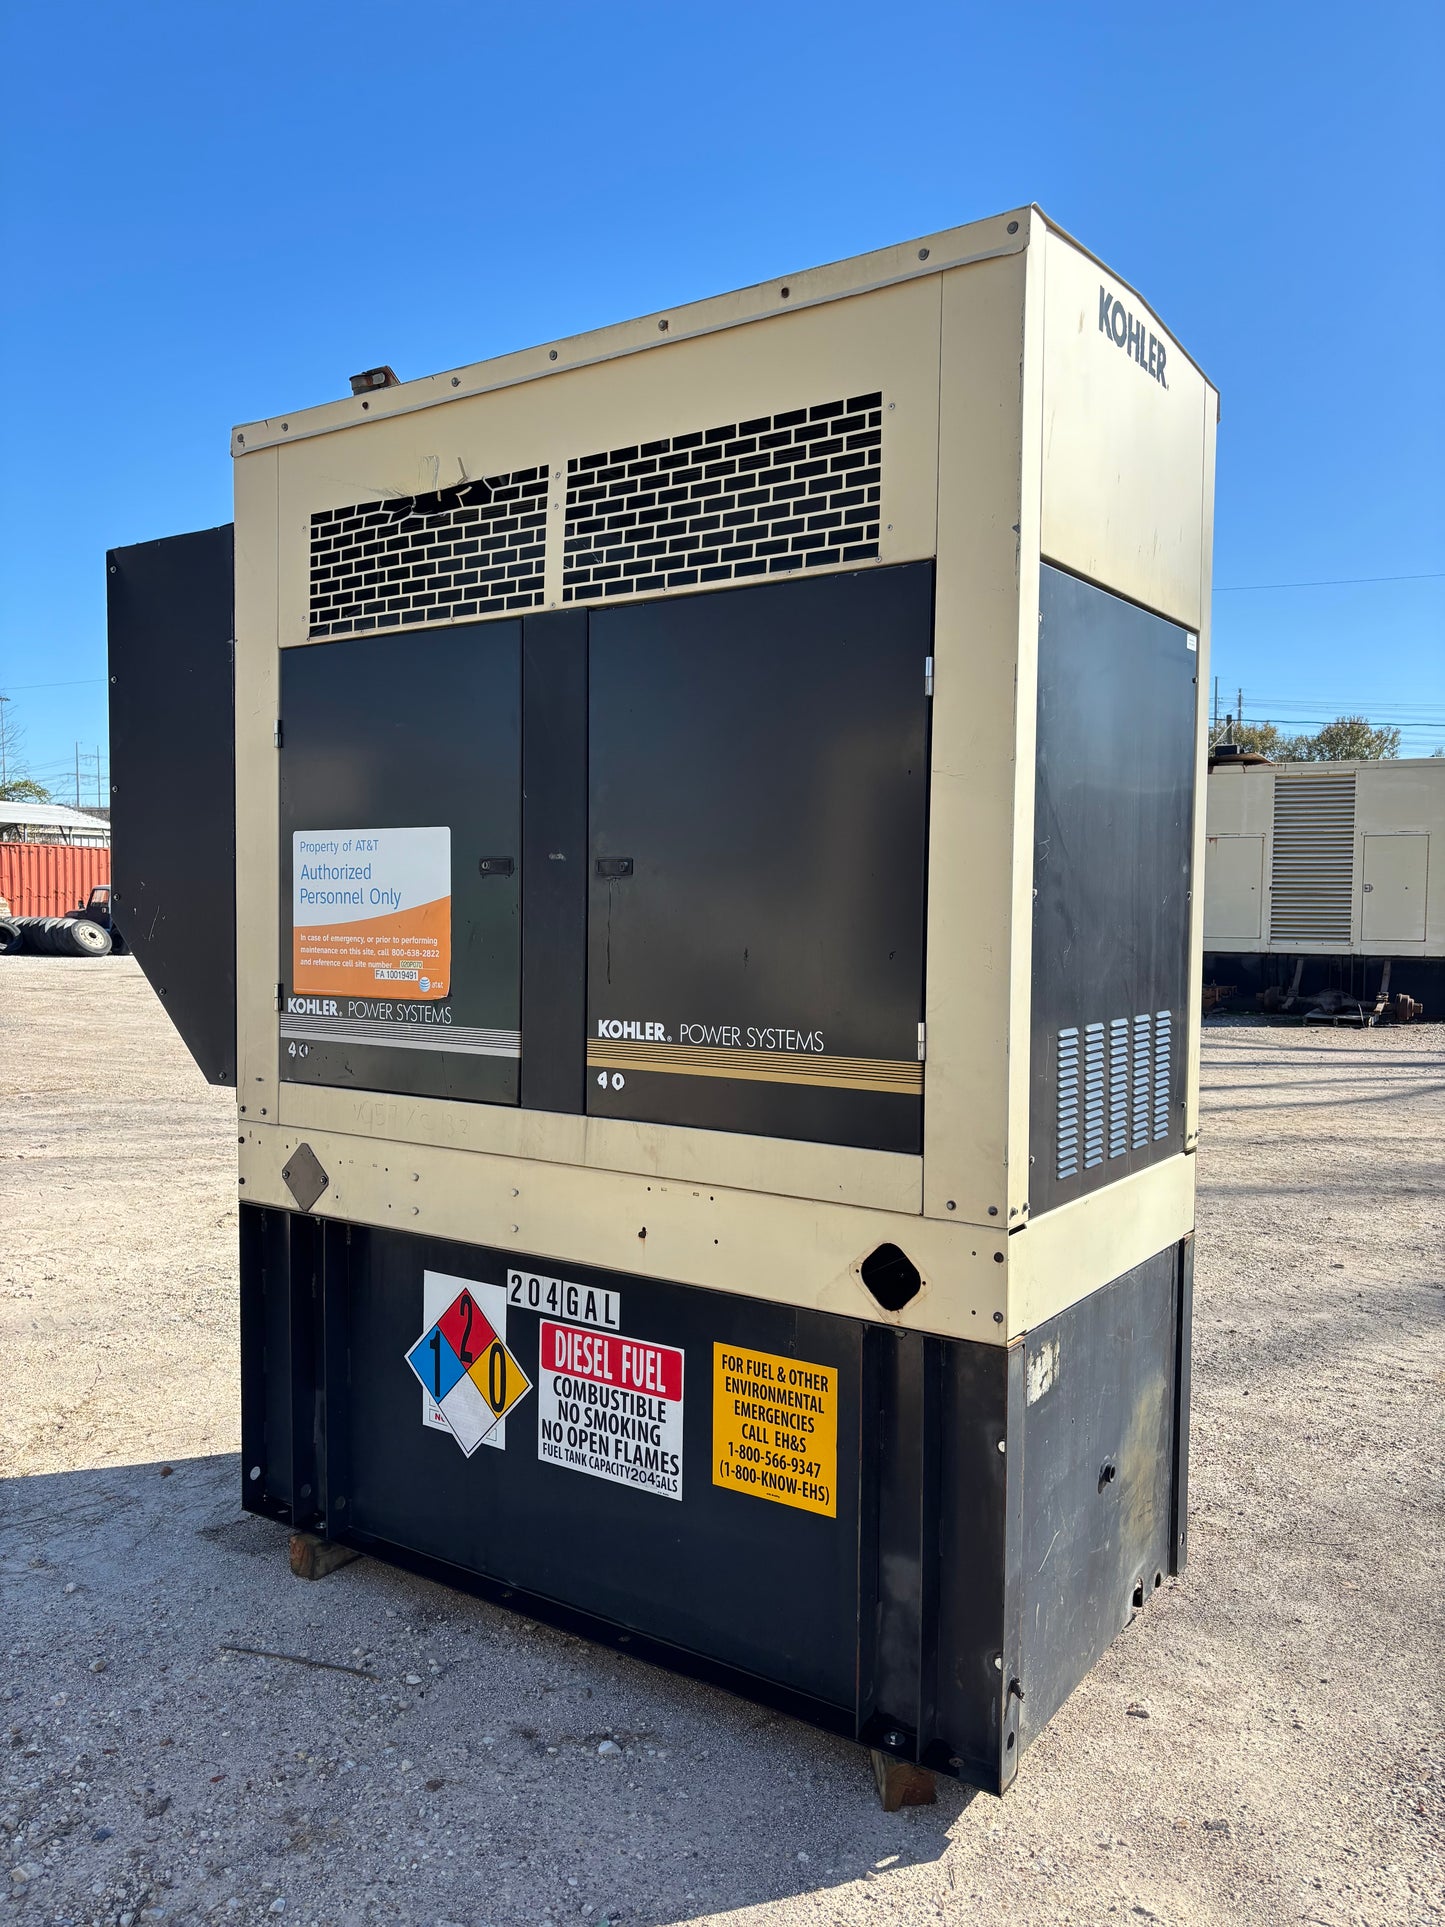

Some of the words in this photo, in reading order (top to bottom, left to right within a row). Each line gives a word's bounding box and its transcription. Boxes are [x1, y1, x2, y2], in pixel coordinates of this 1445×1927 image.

[300, 841, 338, 855] Property
[342, 839, 352, 852] of
[355, 839, 379, 852] AT&T
[300, 862, 372, 880] Authorized
[300, 887, 364, 905] Personnel
[369, 887, 402, 910] Only
[300, 933, 306, 941] In
[307, 934, 321, 942] case
[322, 934, 329, 942] of
[330, 935, 365, 945] emergency,
[375, 935, 391, 945] prior
[392, 936, 400, 944] to
[401, 936, 438, 947] performing
[300, 946, 339, 954] maintenance
[349, 947, 360, 955] this
[377, 947, 390, 956] call
[391, 948, 440, 958] 800-638-2822
[300, 958, 311, 966] and
[312, 958, 341, 967] reference
[342, 959, 353, 967] cell
[354, 960, 367, 968] site
[367, 960, 393, 969] number
[375, 970, 385, 979] FA
[348, 1001, 393, 1021] POWER
[396, 1004, 453, 1025] SYSTEMS
[680, 1023, 742, 1046] POWER
[746, 1027, 825, 1052] SYSTEMS
[597, 1071, 625, 1091] 40
[459, 1294, 473, 1364] 2
[429, 1330, 441, 1398] 1
[555, 1329, 613, 1380] DIESEL
[622, 1344, 666, 1393] FUEL
[722, 1353, 743, 1374] FOR
[746, 1359, 774, 1381] FUEL
[777, 1366, 786, 1383] &
[789, 1369, 828, 1392] OTHER
[489, 1342, 507, 1413] 0
[553, 1375, 667, 1424] COMBUSTIBLE
[725, 1376, 824, 1414] ENVIRONMENTAL
[558, 1399, 580, 1425] NO
[584, 1406, 661, 1447] SMOKING
[734, 1399, 815, 1434] EMERGENCIES
[541, 1418, 563, 1443] NO
[567, 1426, 609, 1457] OPEN
[614, 1438, 680, 1476] FLAMES
[741, 1423, 769, 1445] CALL
[775, 1431, 806, 1453] EH&S
[542, 1442, 563, 1460] FUEL
[564, 1448, 587, 1467] TANK
[728, 1441, 821, 1479] 1-800-566-9347
[719, 1459, 830, 1506] (1-800-KNOW-EHS)
